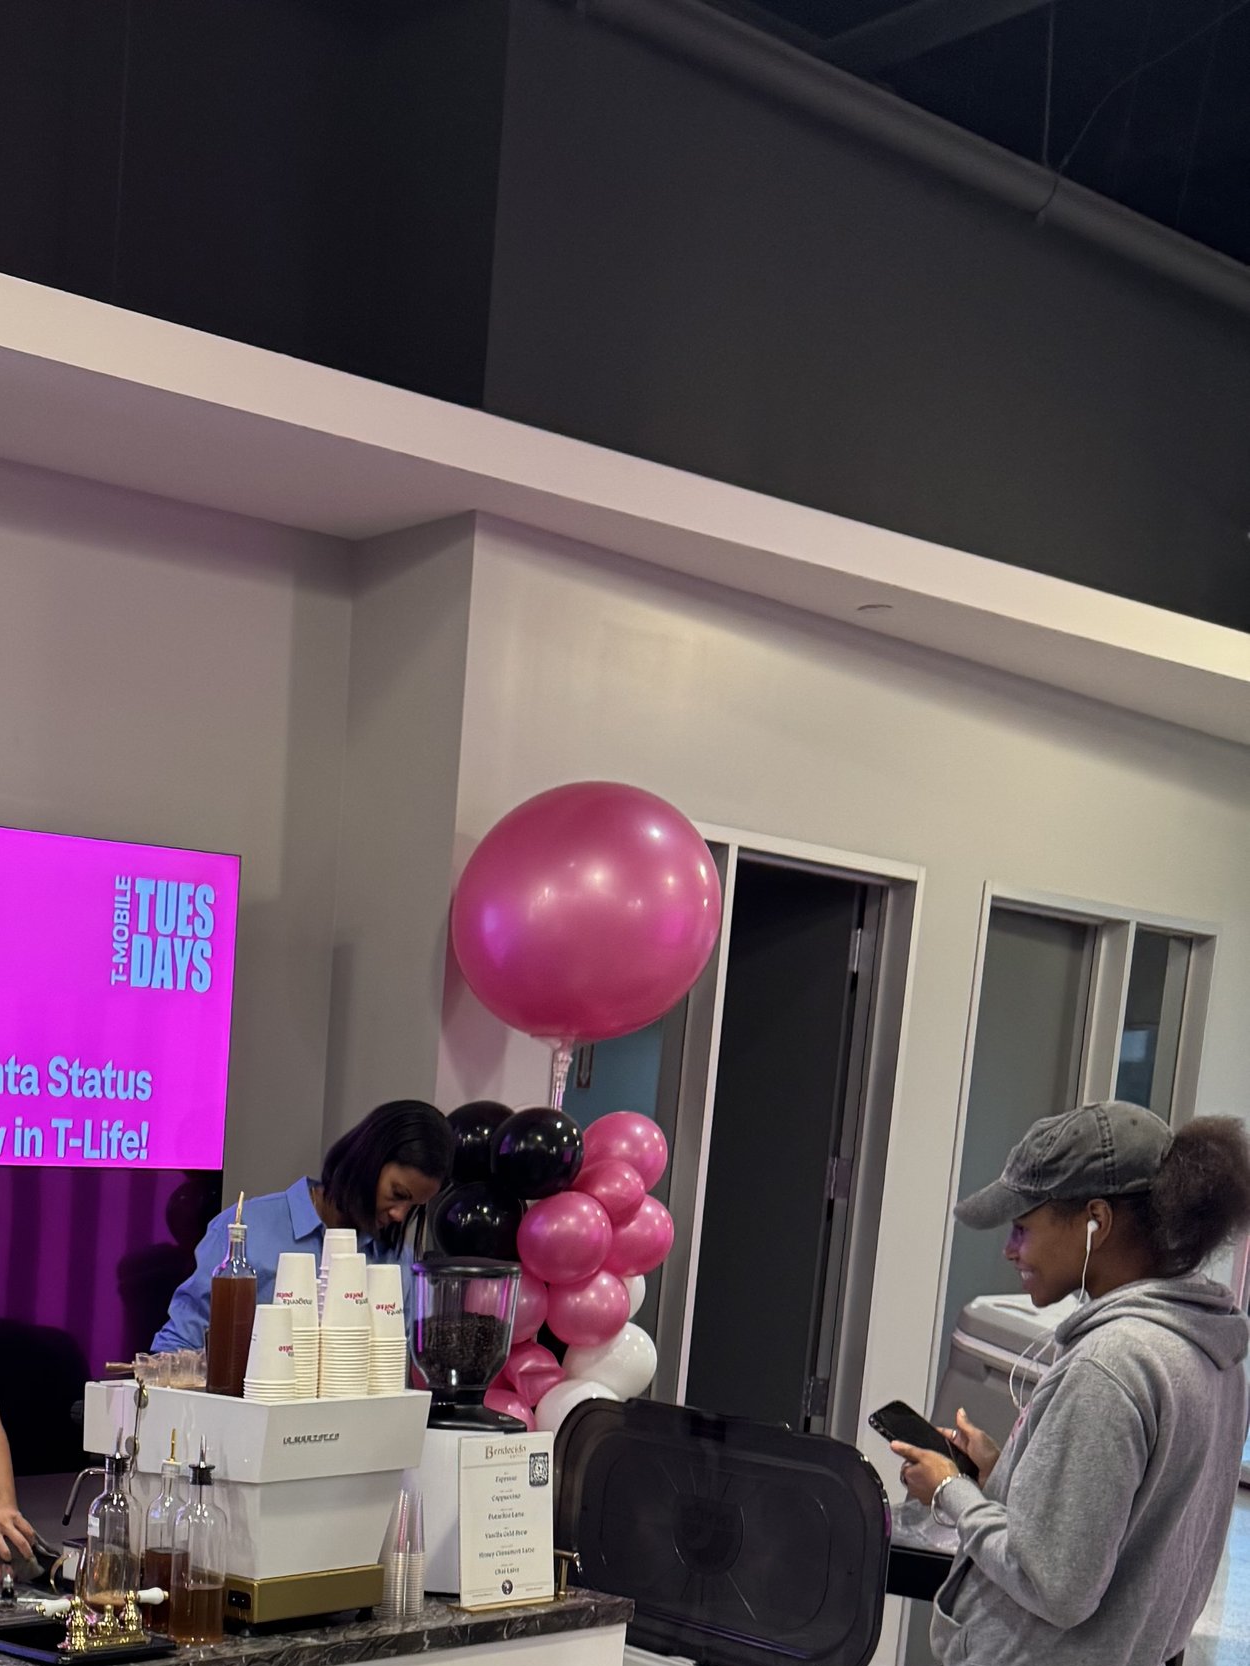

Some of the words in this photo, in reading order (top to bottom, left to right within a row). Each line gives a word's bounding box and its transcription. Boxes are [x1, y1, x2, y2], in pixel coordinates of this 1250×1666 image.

[111, 874, 131, 986] T-MOBILE
[135, 877, 215, 938] TUES
[130, 933, 213, 993] DAYS
[47, 1055, 152, 1101] Status
[13, 1117, 43, 1158] in
[51, 1118, 149, 1161] T-Life!
